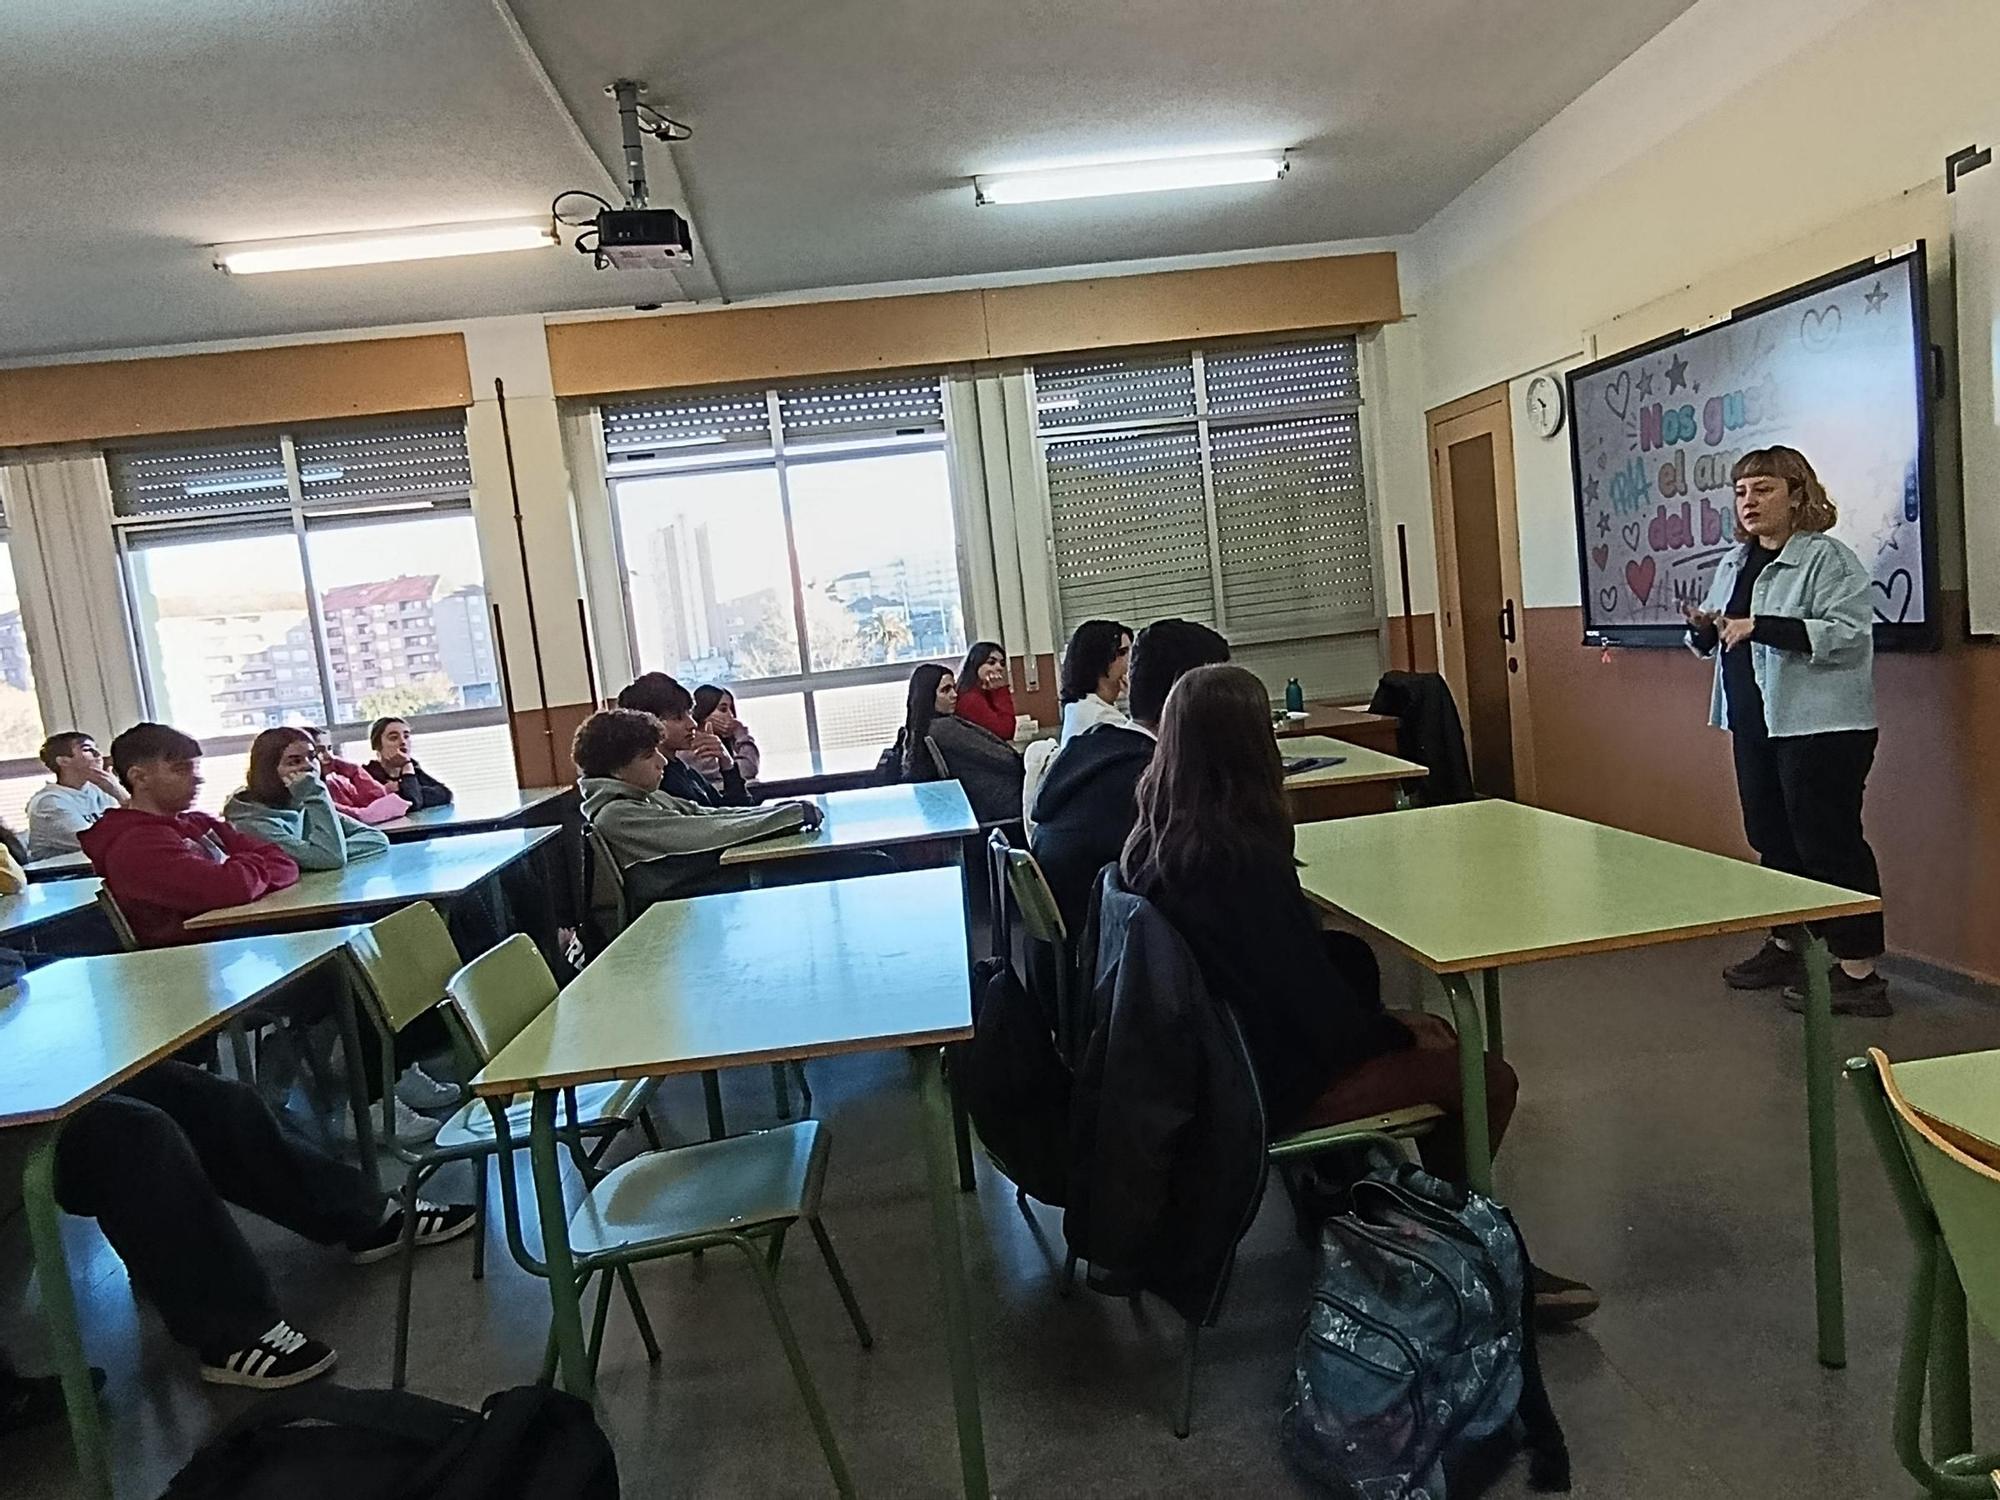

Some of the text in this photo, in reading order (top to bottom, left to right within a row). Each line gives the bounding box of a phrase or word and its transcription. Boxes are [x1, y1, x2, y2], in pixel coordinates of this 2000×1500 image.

[1640, 402, 1697, 452] Nos
[1658, 448, 1687, 498] el
[1648, 501, 1694, 552] del
